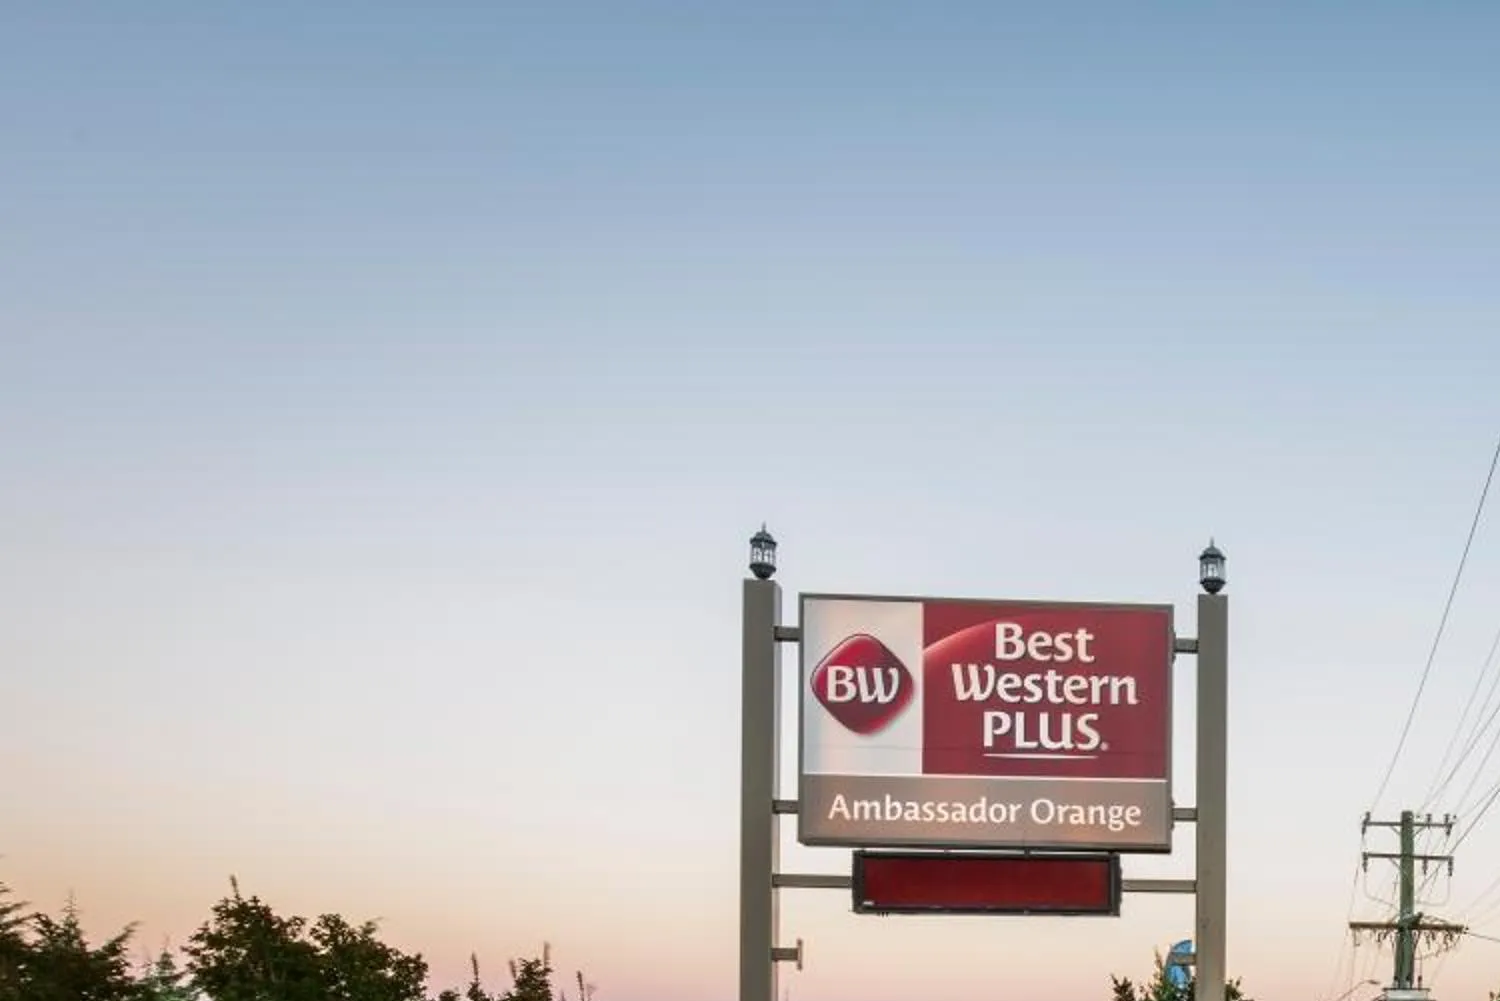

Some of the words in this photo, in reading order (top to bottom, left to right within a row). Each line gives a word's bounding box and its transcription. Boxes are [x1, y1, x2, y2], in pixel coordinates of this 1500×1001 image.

[995, 622, 1095, 662] Best
[826, 664, 899, 704] BW
[952, 662, 1138, 705] Western
[828, 794, 1021, 824] Ambassador
[1030, 798, 1142, 831] Orange
